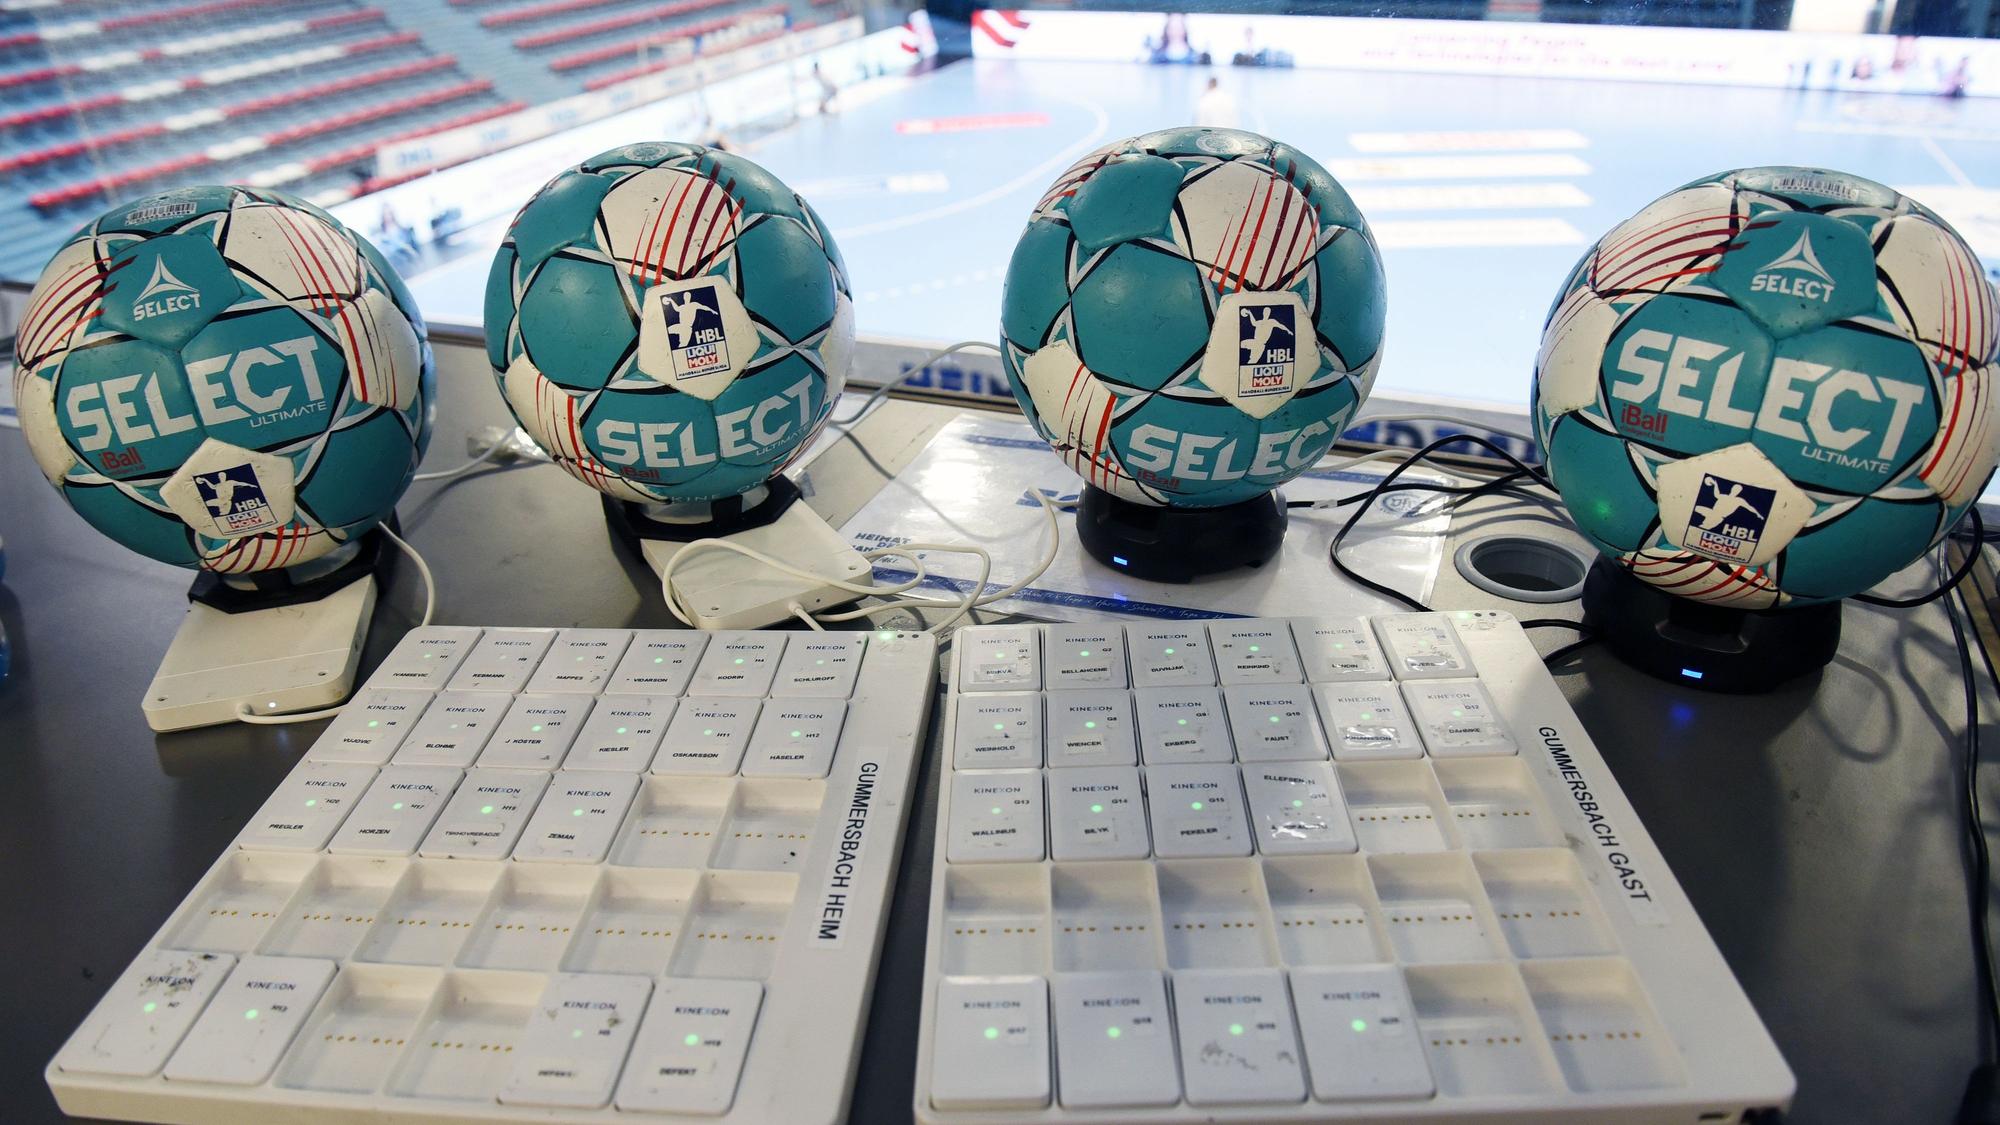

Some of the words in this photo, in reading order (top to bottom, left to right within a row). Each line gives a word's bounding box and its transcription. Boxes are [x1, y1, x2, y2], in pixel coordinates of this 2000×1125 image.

[1750, 275, 1835, 302] SELECT
[134, 293, 201, 322] SELECT
[695, 328, 724, 344] HBL
[686, 344, 716, 358] LIQUI
[1267, 348, 1294, 363] HBL
[688, 354, 719, 368] MOLY
[1253, 365, 1283, 377] LIQUI
[1252, 376, 1283, 387] MOLY
[65, 336, 320, 452] SELECT
[1612, 328, 1925, 461] SELECT
[249, 400, 328, 428] ULTIMATE
[596, 374, 813, 468] SELECT
[1621, 400, 1668, 433] iBall
[1801, 445, 1891, 474] ULTIMATE
[235, 497, 267, 512] HBL
[229, 518, 262, 529] MOLY
[1702, 532, 1740, 548] LIQUI
[1722, 524, 1757, 541] HBL
[1700, 540, 1739, 555] MOLY
[391, 784, 433, 792] KINEXON
[1539, 726, 1620, 847] GUMMERSBACH
[1608, 852, 1652, 903] GAST
[831, 762, 879, 888] GUMMERSBACH
[818, 894, 847, 940] HEIM
[246, 982, 296, 990] KINEXON
[564, 1002, 616, 1010] KINEXON
[675, 1007, 729, 1015] KINEXON
